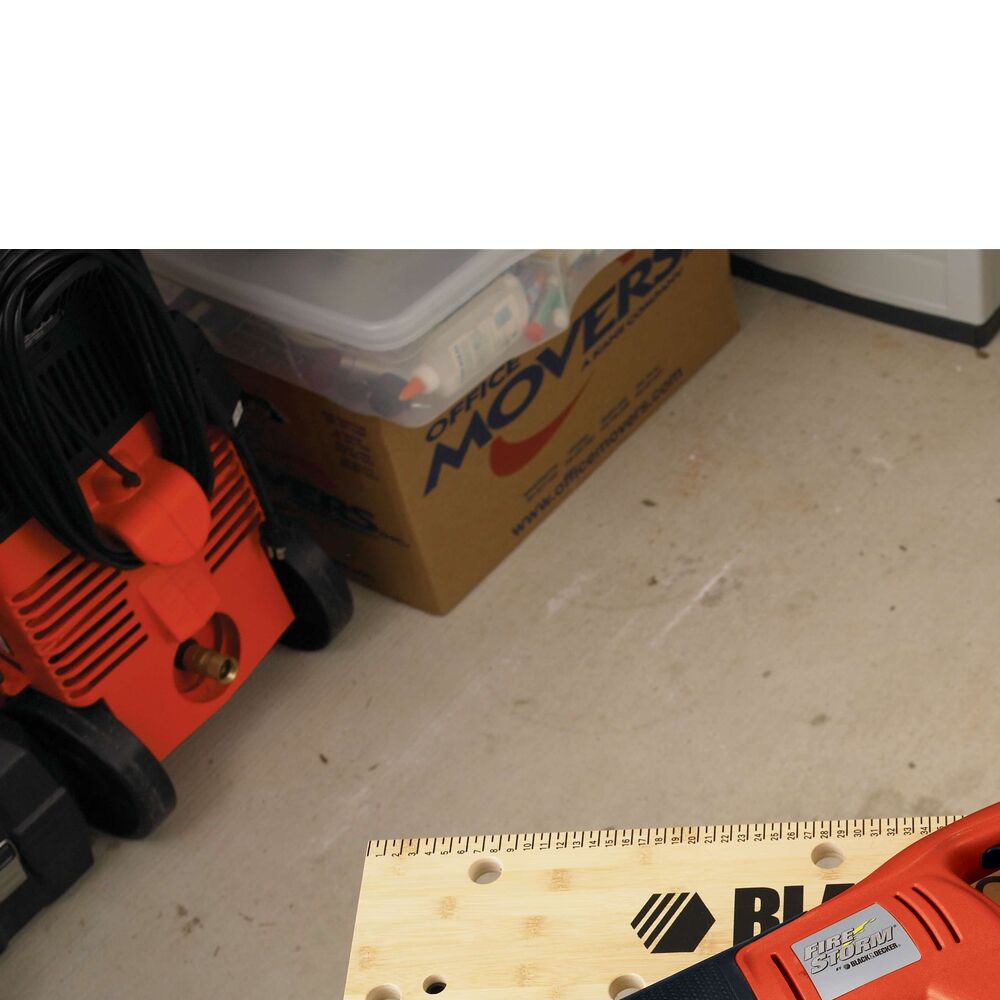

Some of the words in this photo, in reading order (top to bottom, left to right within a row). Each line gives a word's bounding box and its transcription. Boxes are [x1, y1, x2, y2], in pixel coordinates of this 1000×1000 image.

[424, 249, 683, 497] MOVERS
[804, 927, 857, 961] FIRE
[811, 925, 895, 974] STORM
